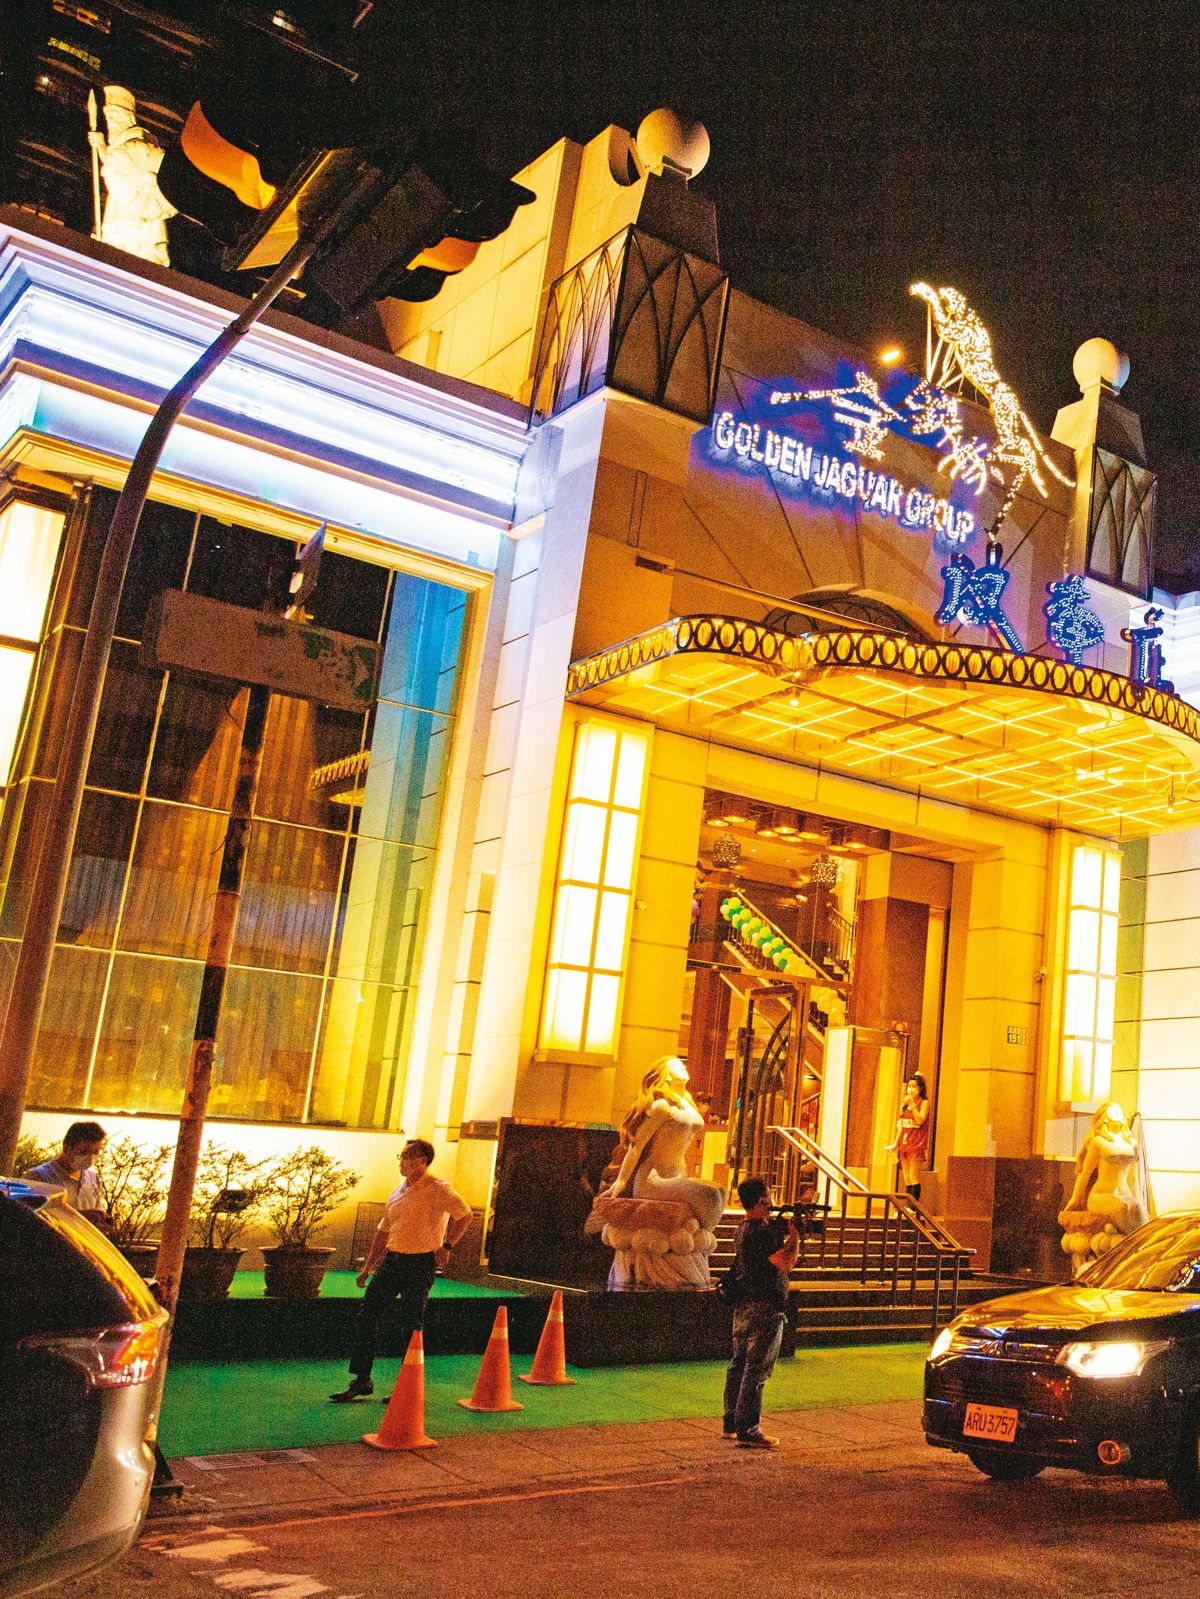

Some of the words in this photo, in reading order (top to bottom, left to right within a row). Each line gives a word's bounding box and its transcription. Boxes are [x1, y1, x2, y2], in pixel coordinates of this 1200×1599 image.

[715, 411, 813, 481] GOLDEN
[814, 454, 904, 516] JAGUAR
[905, 487, 975, 544] GROUP
